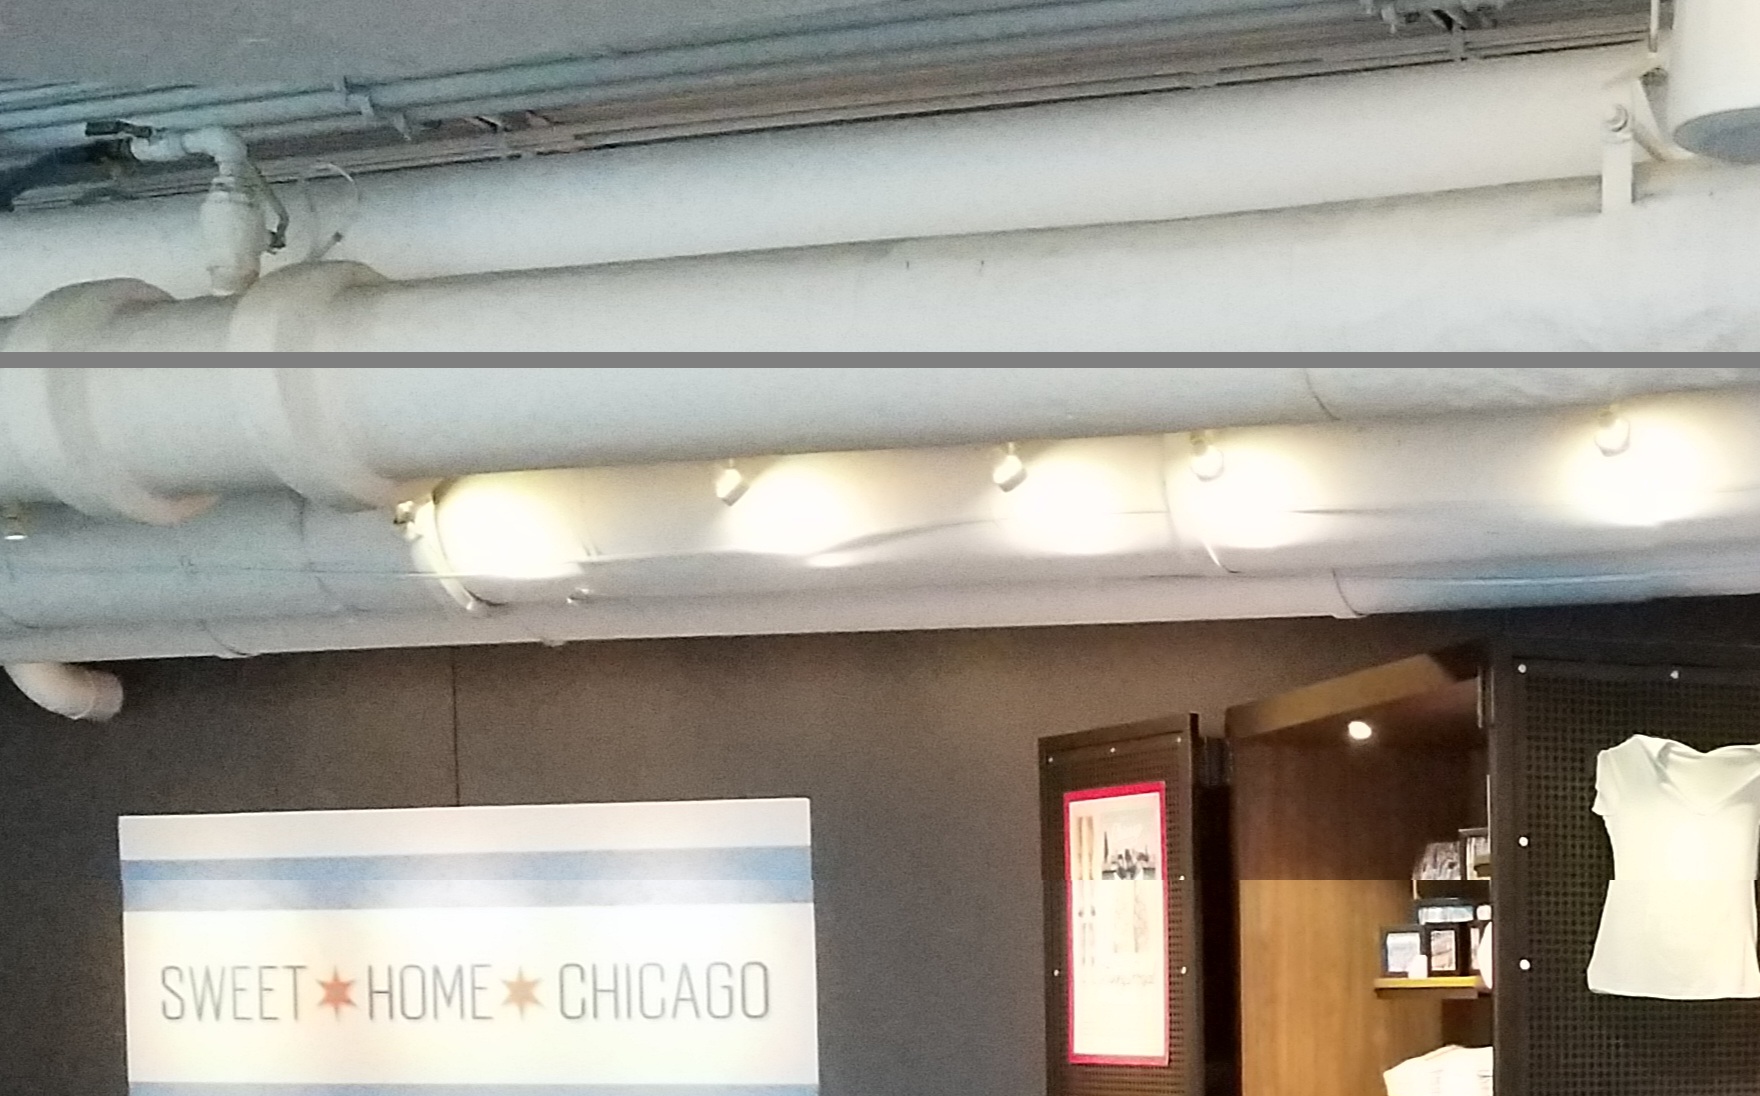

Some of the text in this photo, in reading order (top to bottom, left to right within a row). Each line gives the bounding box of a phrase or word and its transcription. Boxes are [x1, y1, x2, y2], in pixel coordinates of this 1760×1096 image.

[160, 960, 771, 1022] SWEET HOME CHICAGO
